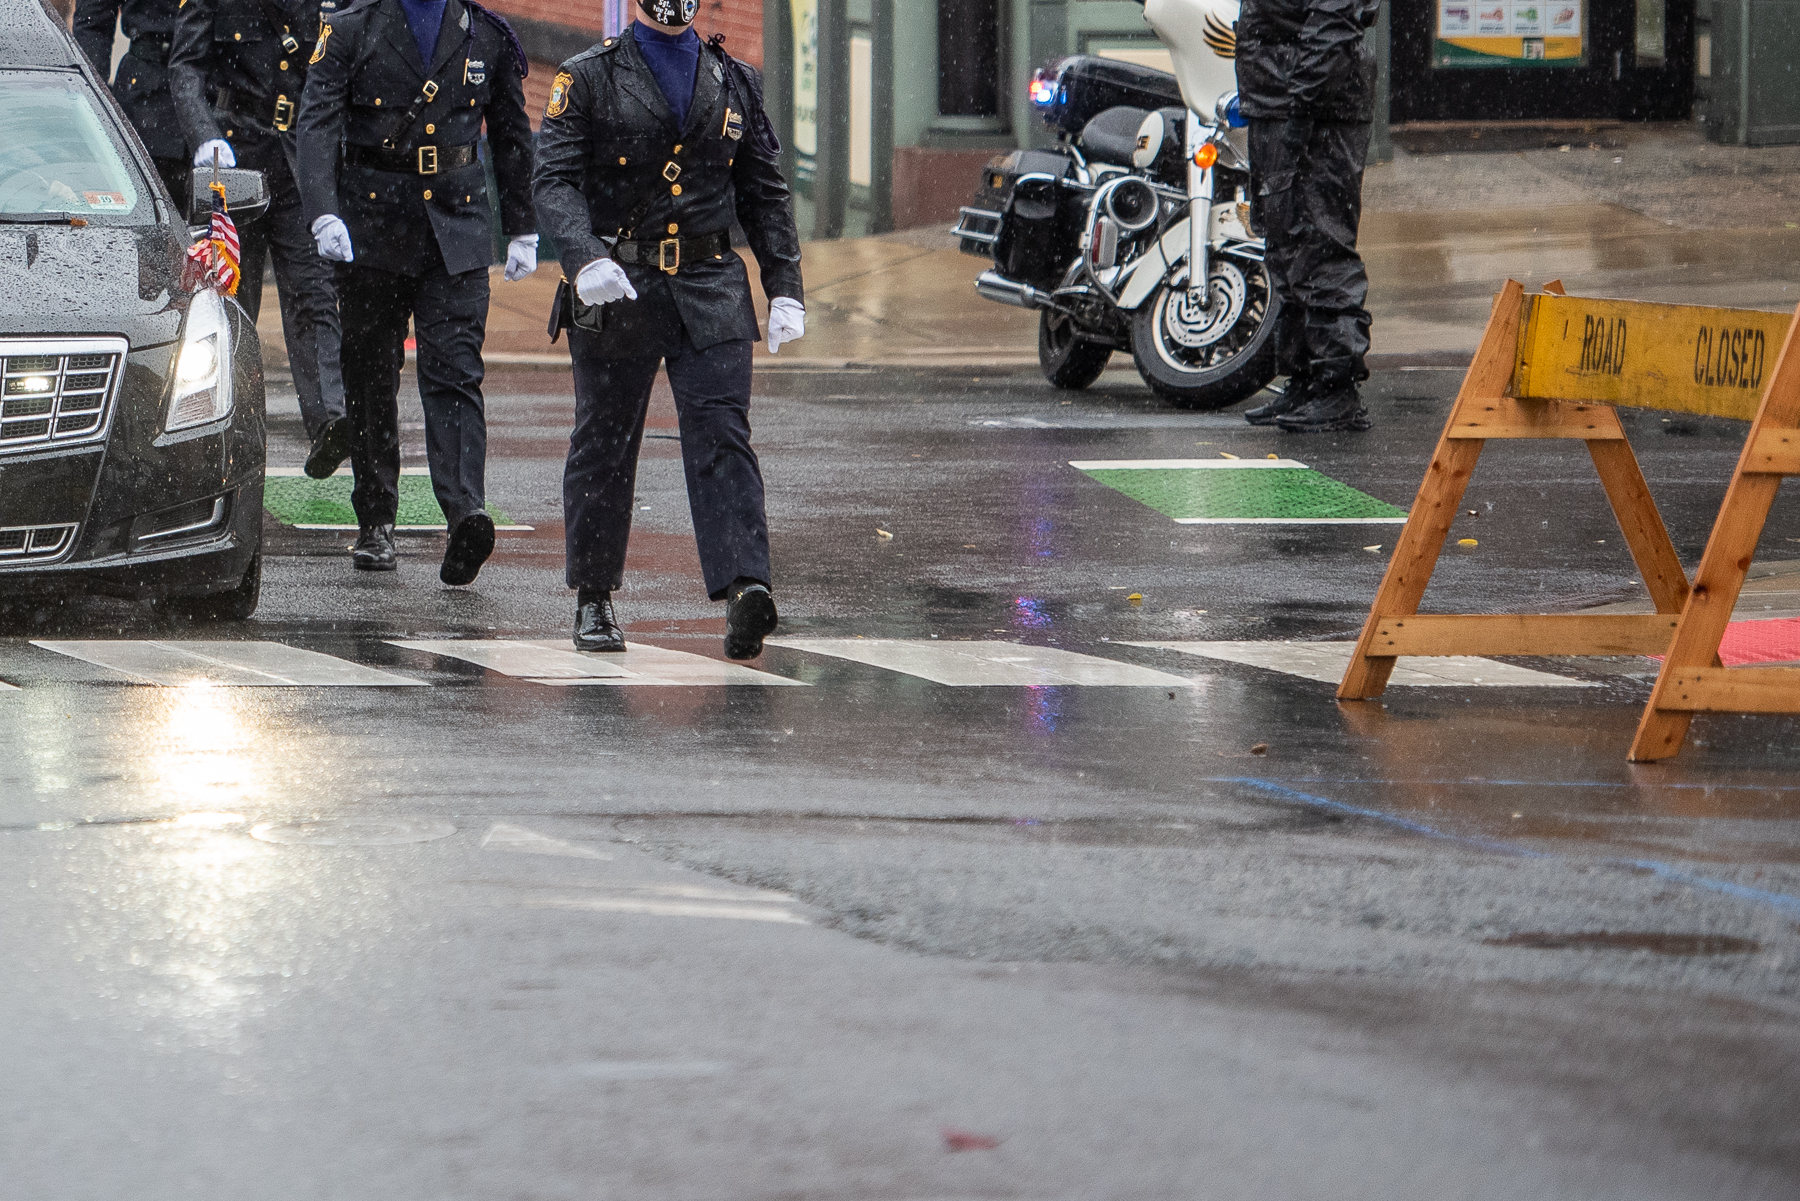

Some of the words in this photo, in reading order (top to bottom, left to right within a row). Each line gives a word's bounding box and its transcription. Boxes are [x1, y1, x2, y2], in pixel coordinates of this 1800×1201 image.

[656, 13, 669, 24] S-6
[1581, 314, 1627, 376] ROAD
[1693, 325, 1766, 389] CLOSED
